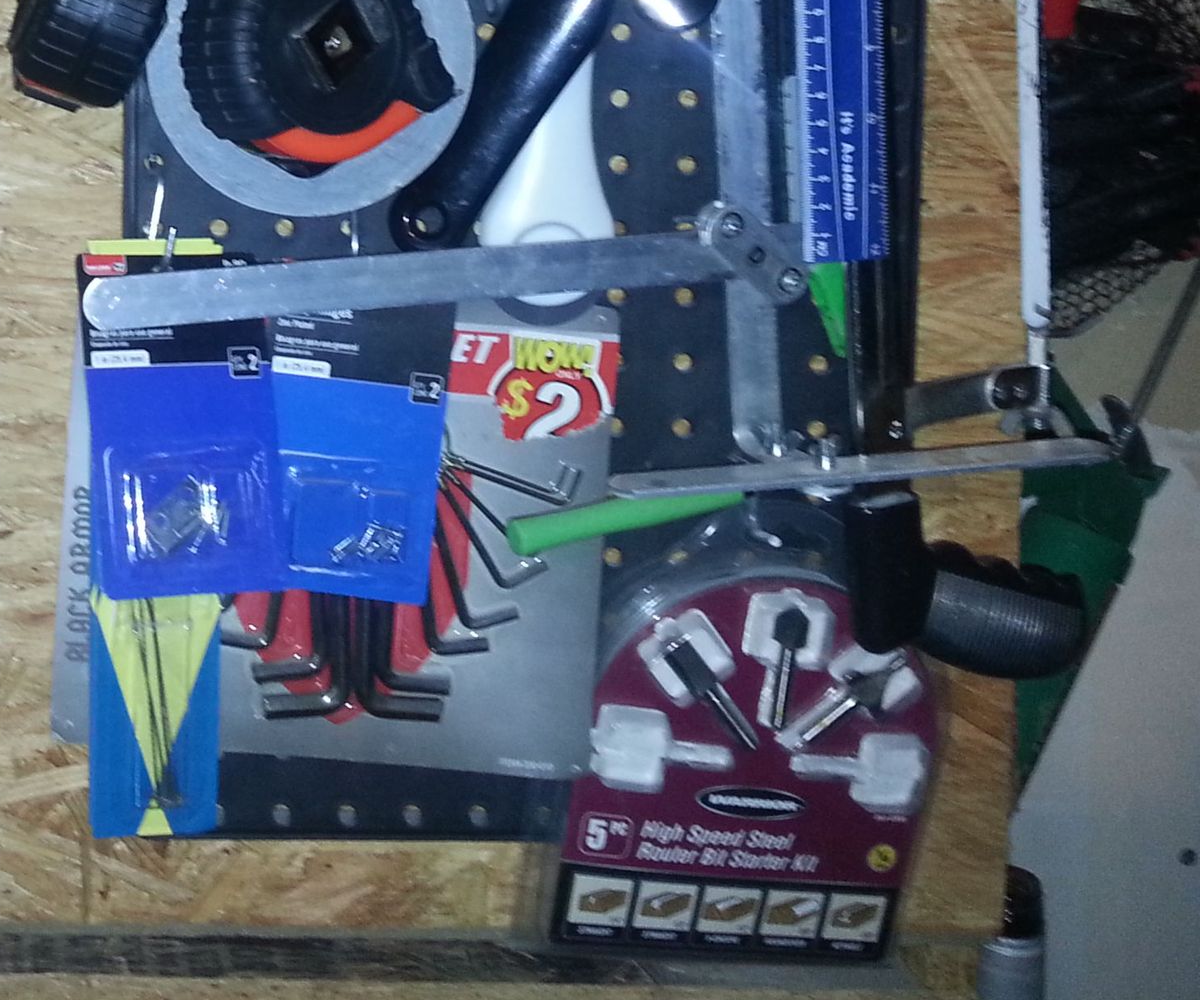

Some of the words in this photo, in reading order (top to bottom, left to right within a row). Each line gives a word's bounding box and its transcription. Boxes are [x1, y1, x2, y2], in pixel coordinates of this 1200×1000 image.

[839, 111, 855, 136] It's
[840, 142, 858, 222] Academic
[247, 353, 260, 371] 2
[450, 333, 501, 365] ET
[513, 336, 596, 378] WOW!
[428, 381, 441, 399] 2
[584, 818, 609, 852] 5
[639, 819, 686, 843] High
[686, 823, 745, 850] Speed
[745, 829, 796, 851] Steel
[635, 841, 700, 866] Router
[699, 846, 728, 868] Bit
[727, 848, 792, 872] Starter
[791, 853, 820, 873] Kit
